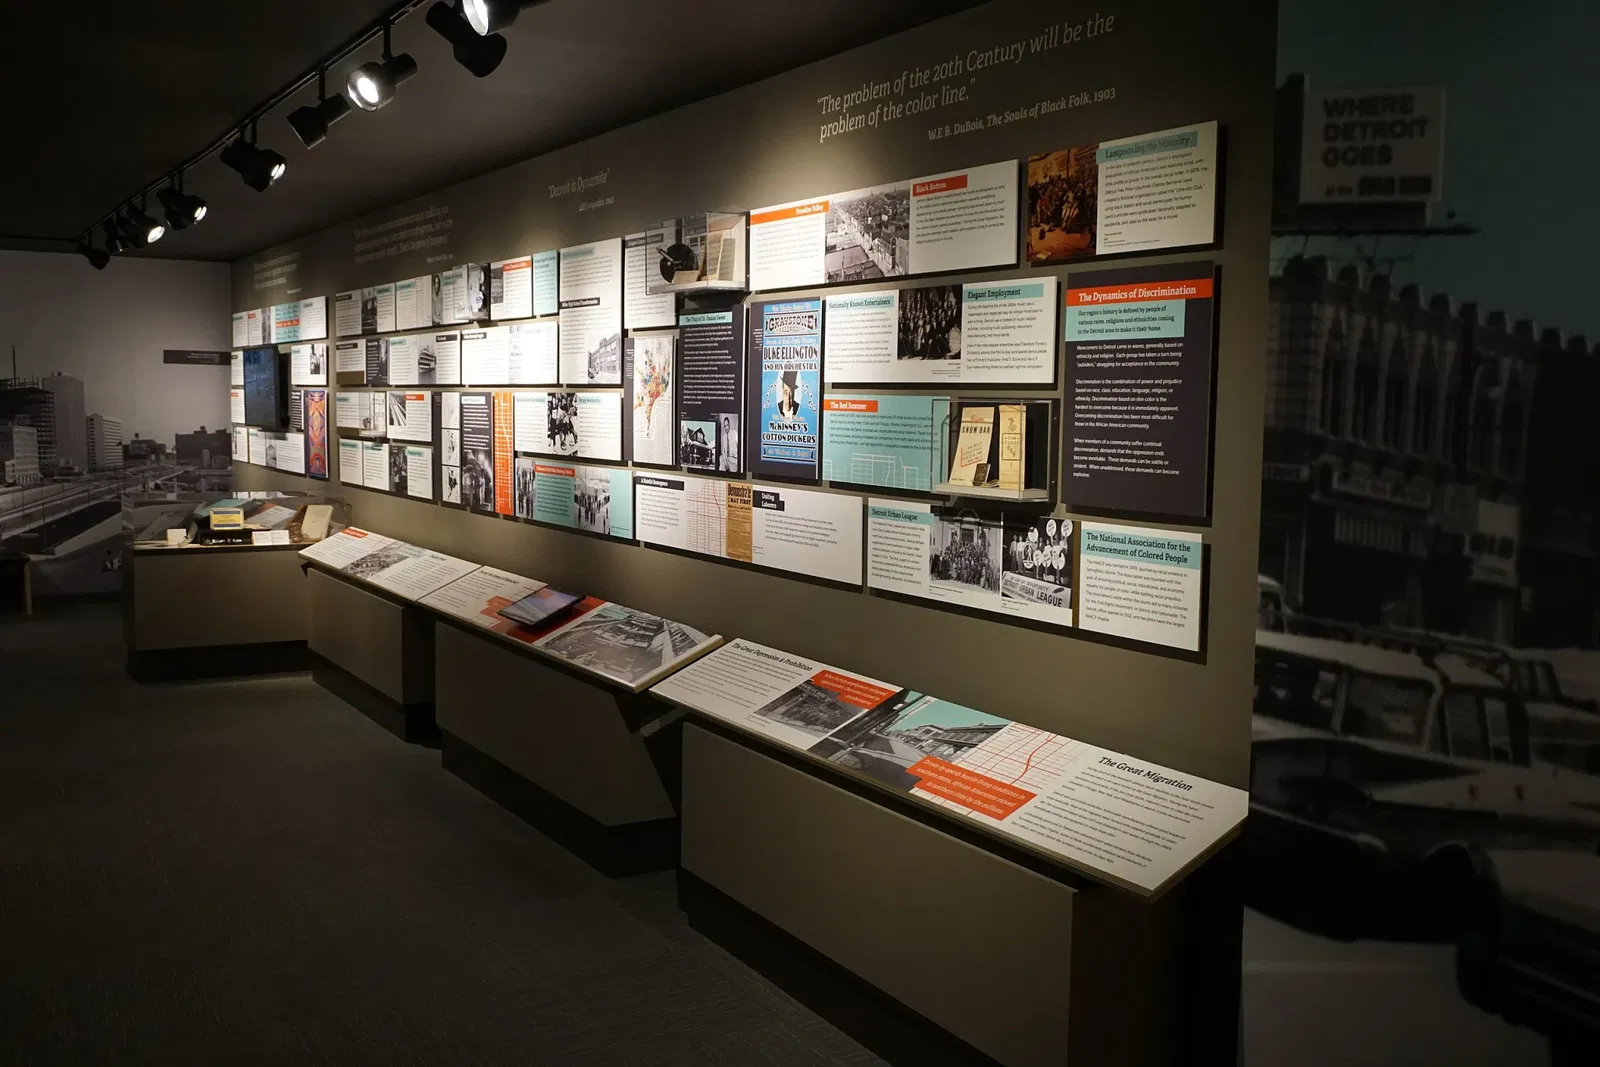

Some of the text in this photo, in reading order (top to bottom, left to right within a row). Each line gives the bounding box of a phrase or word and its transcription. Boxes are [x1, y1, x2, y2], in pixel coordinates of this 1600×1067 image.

[844, 82, 890, 113] problem
[894, 72, 907, 96] of
[910, 68, 930, 89] the
[933, 56, 963, 82] 20th
[967, 41, 1025, 71] Century
[1030, 25, 1058, 53] will
[1063, 21, 1082, 44] be
[1086, 10, 1114, 37] the
[954, 119, 984, 135] DuBois,
[986, 114, 1003, 127] The
[1004, 107, 1028, 122] Souls
[1029, 103, 1040, 119] of
[1041, 98, 1066, 114] Black
[1068, 93, 1091, 108] Folk,
[1093, 87, 1116, 103] 1903
[1323, 94, 1414, 117] WHERE
[820, 113, 865, 142] problem
[868, 105, 881, 128] of
[883, 100, 902, 121] the
[906, 92, 938, 115] color
[1322, 117, 1428, 143] DETROIT
[1322, 145, 1392, 168] GOES
[968, 289, 1021, 300] Elegant Employment
[1079, 285, 1196, 303] The Dynamics of Discrimination
[764, 346, 817, 360] DUKE ELLINGTON
[830, 401, 838, 409] The
[848, 402, 867, 410] Summer
[763, 434, 815, 443] COTTON PICKERS
[872, 508, 917, 521] Detroit Urban League
[1087, 533, 1190, 552] The National Association for the
[1086, 544, 1188, 564] Advancement of Colored People
[1037, 591, 1062, 607] LEAGUE
[753, 650, 780, 660] Depression
[783, 659, 813, 671] Prohibition
[923, 760, 940, 768] Driven
[1098, 757, 1193, 791] The Great Migration
